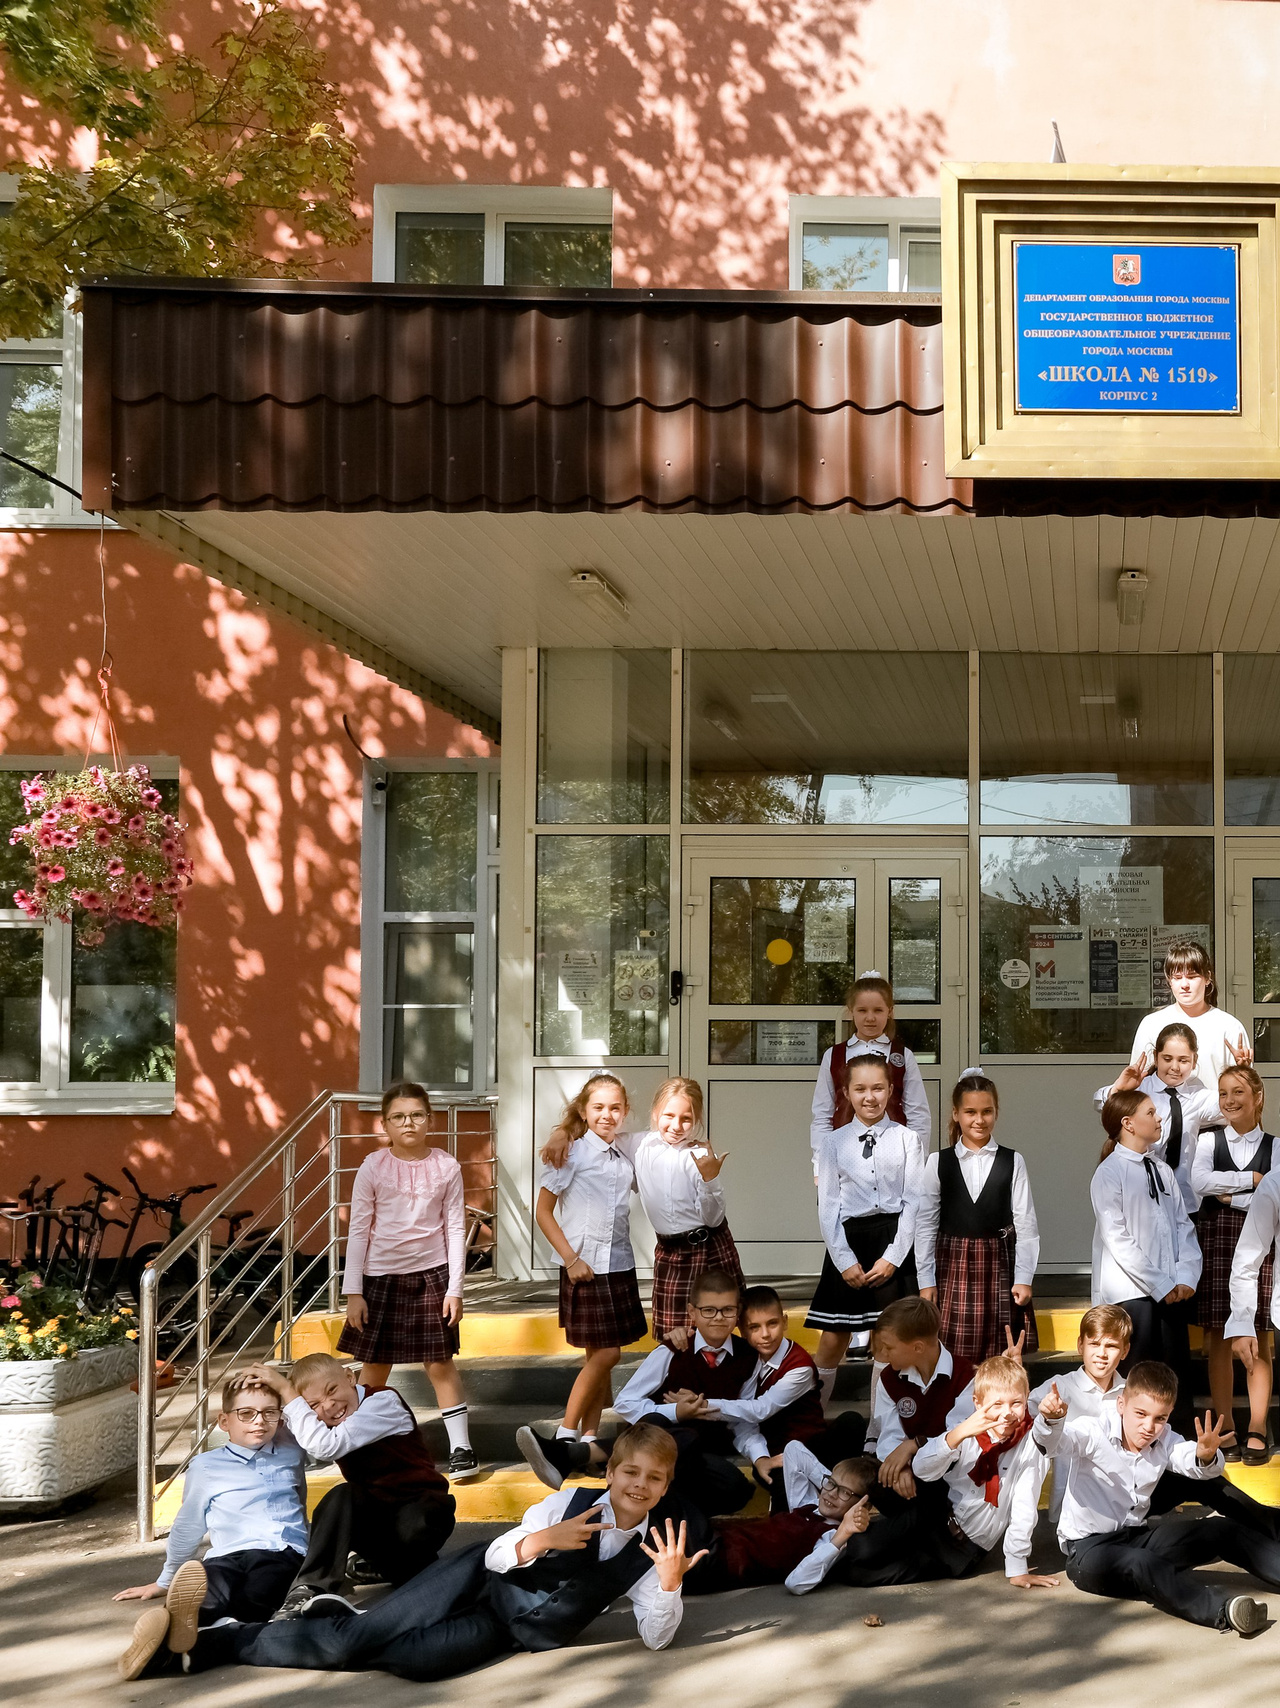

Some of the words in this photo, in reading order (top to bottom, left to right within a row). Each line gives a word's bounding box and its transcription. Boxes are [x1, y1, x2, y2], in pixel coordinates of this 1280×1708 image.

[1023, 294, 1087, 303] ДЕПАРТАМЕНТ
[1089, 294, 1153, 303] ОБРАЗОВАНИЯ
[1155, 295, 1189, 304] ГОРОДА
[1191, 296, 1230, 304] МОСКВЫ
[1040, 312, 1143, 322] ГОСУДАРСТВЕННОЕ
[1145, 313, 1214, 323] БЮДЖЕТНОЕ
[1023, 329, 1157, 339] ОБЩЕОБРАЗОВАТЕЛЬНОЕ
[1159, 330, 1231, 340] УЧРЕЖДЕНИЕ
[1082, 346, 1124, 356] ГОРОДА
[1127, 347, 1173, 356] МОСКВЫ
[1037, 366, 1132, 382] «ШКОЛА
[1138, 367, 1160, 383] №
[1167, 367, 1219, 383] 1519»
[1099, 391, 1149, 401] КОРПУС
[1151, 391, 1158, 401] 2
